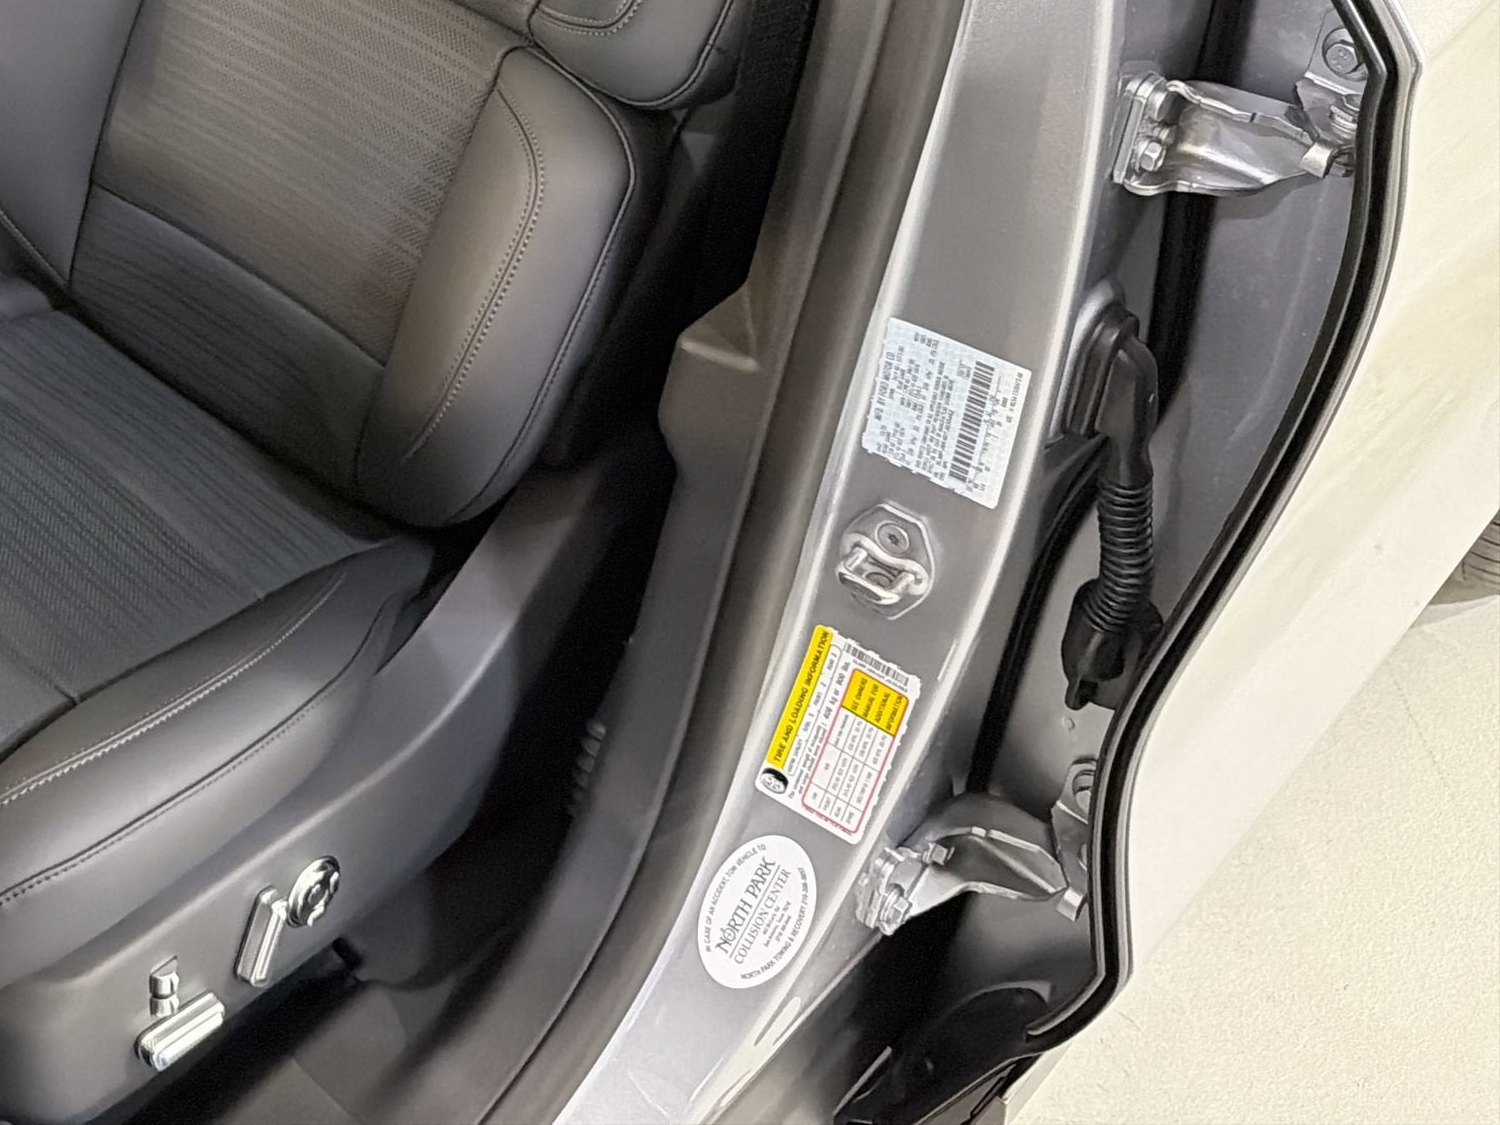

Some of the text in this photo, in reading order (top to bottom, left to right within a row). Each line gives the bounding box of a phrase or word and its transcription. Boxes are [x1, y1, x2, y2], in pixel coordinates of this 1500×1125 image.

[773, 629, 830, 763] TIRE AND LOADING INFORMATION
[708, 906, 715, 915] AN
[715, 856, 776, 954] NORTH PARK
[734, 911, 769, 963] COLLISION
[764, 869, 791, 909] CENTER
[740, 970, 761, 979] NORTH
[761, 960, 776, 972] PARK
[774, 940, 791, 961] TOWING
[792, 906, 805, 937] RECOVERY
